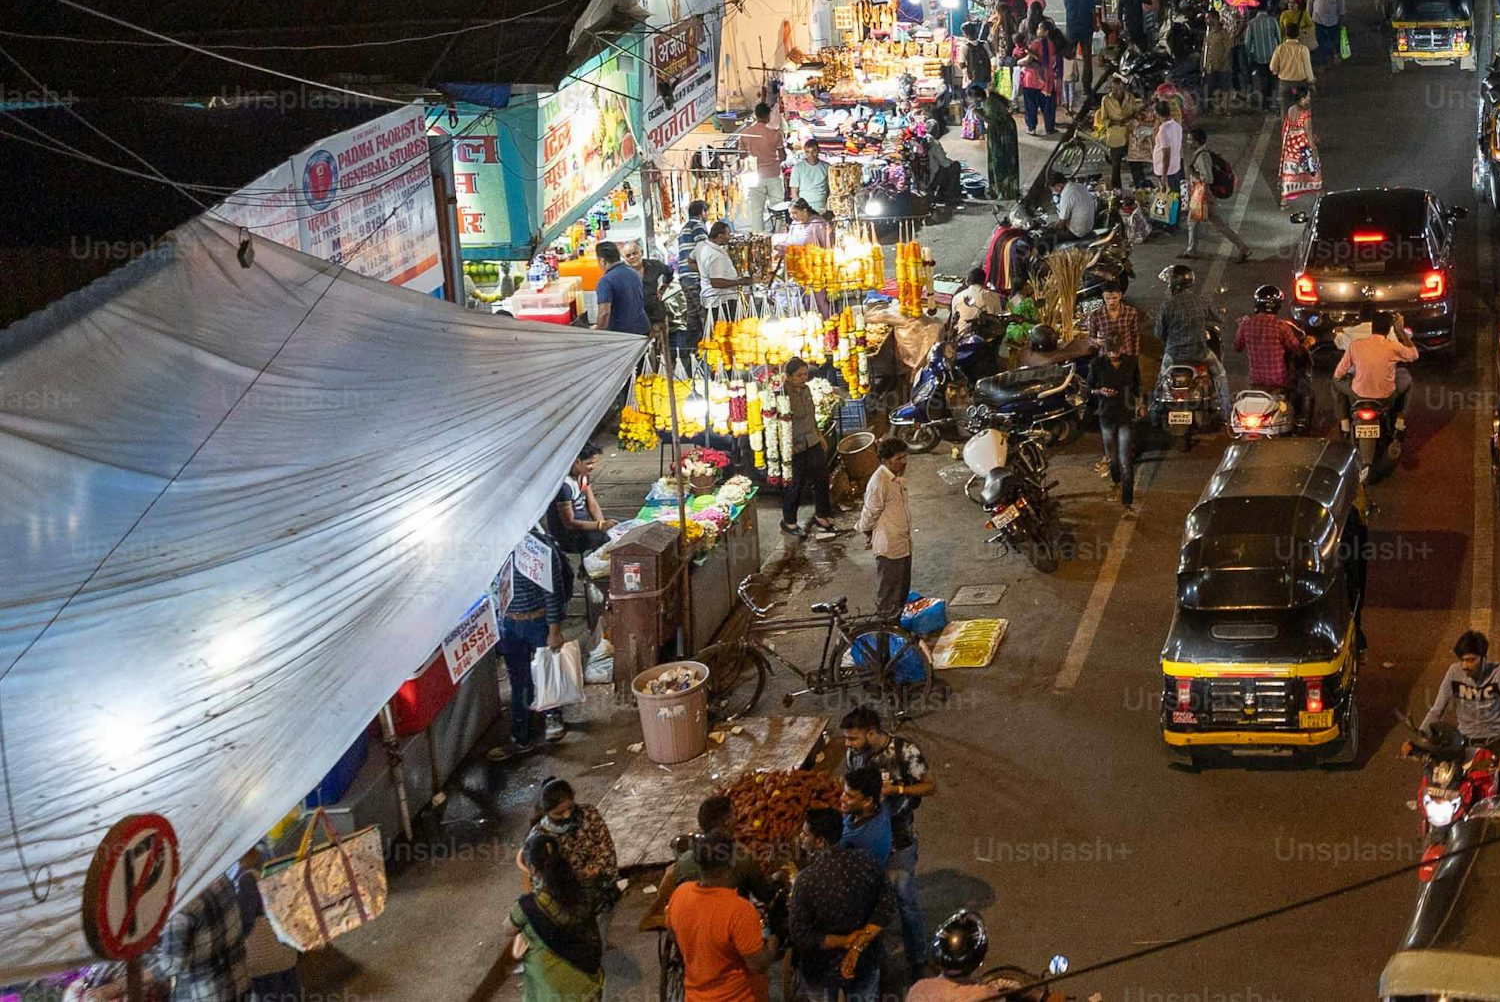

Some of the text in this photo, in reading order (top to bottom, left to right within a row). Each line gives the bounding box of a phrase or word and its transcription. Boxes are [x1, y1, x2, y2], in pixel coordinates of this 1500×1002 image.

[337, 140, 376, 170] PADMA
[376, 118, 416, 152] FLORIST
[340, 156, 389, 190] GENERAL
[389, 136, 428, 167] STORES
[454, 622, 489, 661] LASSI
[1458, 683, 1495, 701] NYC
